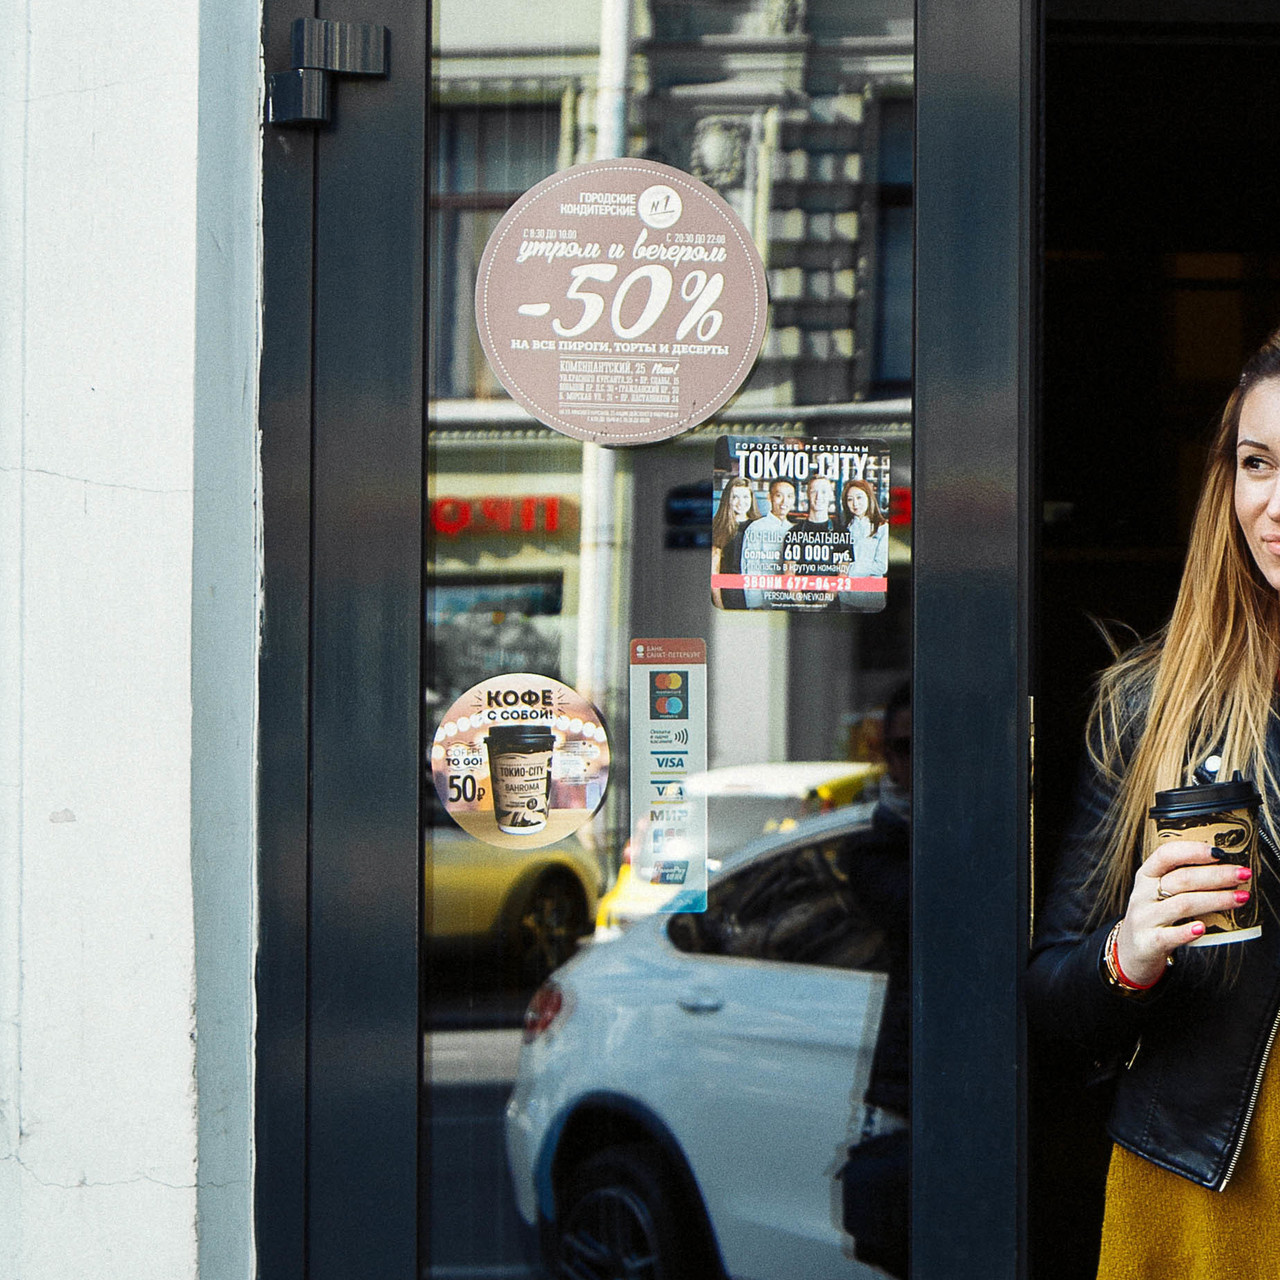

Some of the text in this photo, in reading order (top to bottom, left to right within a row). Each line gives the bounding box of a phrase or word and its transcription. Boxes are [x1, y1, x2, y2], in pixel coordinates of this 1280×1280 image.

[579, 192, 637, 205] ГОРОДСКИЕ
[560, 204, 637, 217] КОНДИТЕРСКИЕ
[516, 227, 728, 268] утром и вечером
[517, 263, 726, 342] -50%
[510, 338, 729, 355] НА ВСЕ ПИРОГИ, ТОРТЫ И ДЕСЕРТЫ
[735, 442, 869, 453] ГОРОДСКИЕ РЕСТОРАНЫ
[735, 450, 869, 481] ТОКИО-CITY
[785, 531, 855, 545] ЗАРАБАТЫВАТЬ
[784, 544, 801, 561] 60
[832, 550, 853, 564] руб.
[743, 576, 782, 588] ЗВОНИ
[486, 689, 554, 708] КОФЕ
[500, 708, 554, 720] СОБОЙ!
[446, 757, 483, 766] TO GO!
[656, 757, 685, 768] VISA
[656, 786, 684, 797] VA
